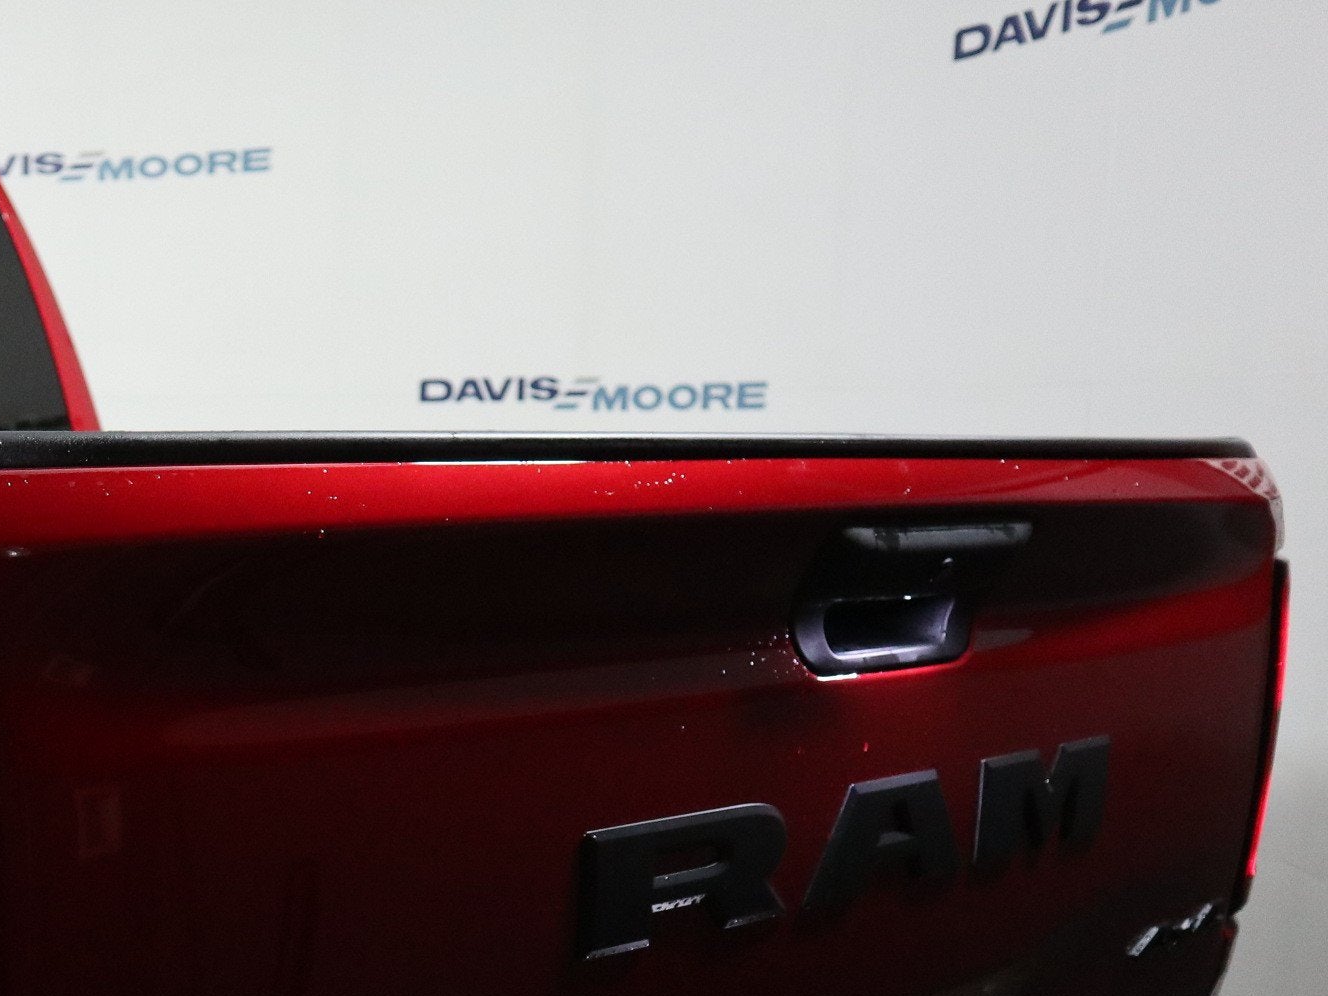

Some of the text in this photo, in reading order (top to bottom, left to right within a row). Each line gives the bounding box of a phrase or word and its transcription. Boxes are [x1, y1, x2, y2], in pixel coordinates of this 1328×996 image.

[98, 147, 272, 181] MOORE
[421, 377, 767, 411] DAVIS MOORE
[579, 734, 1112, 960] RAM
